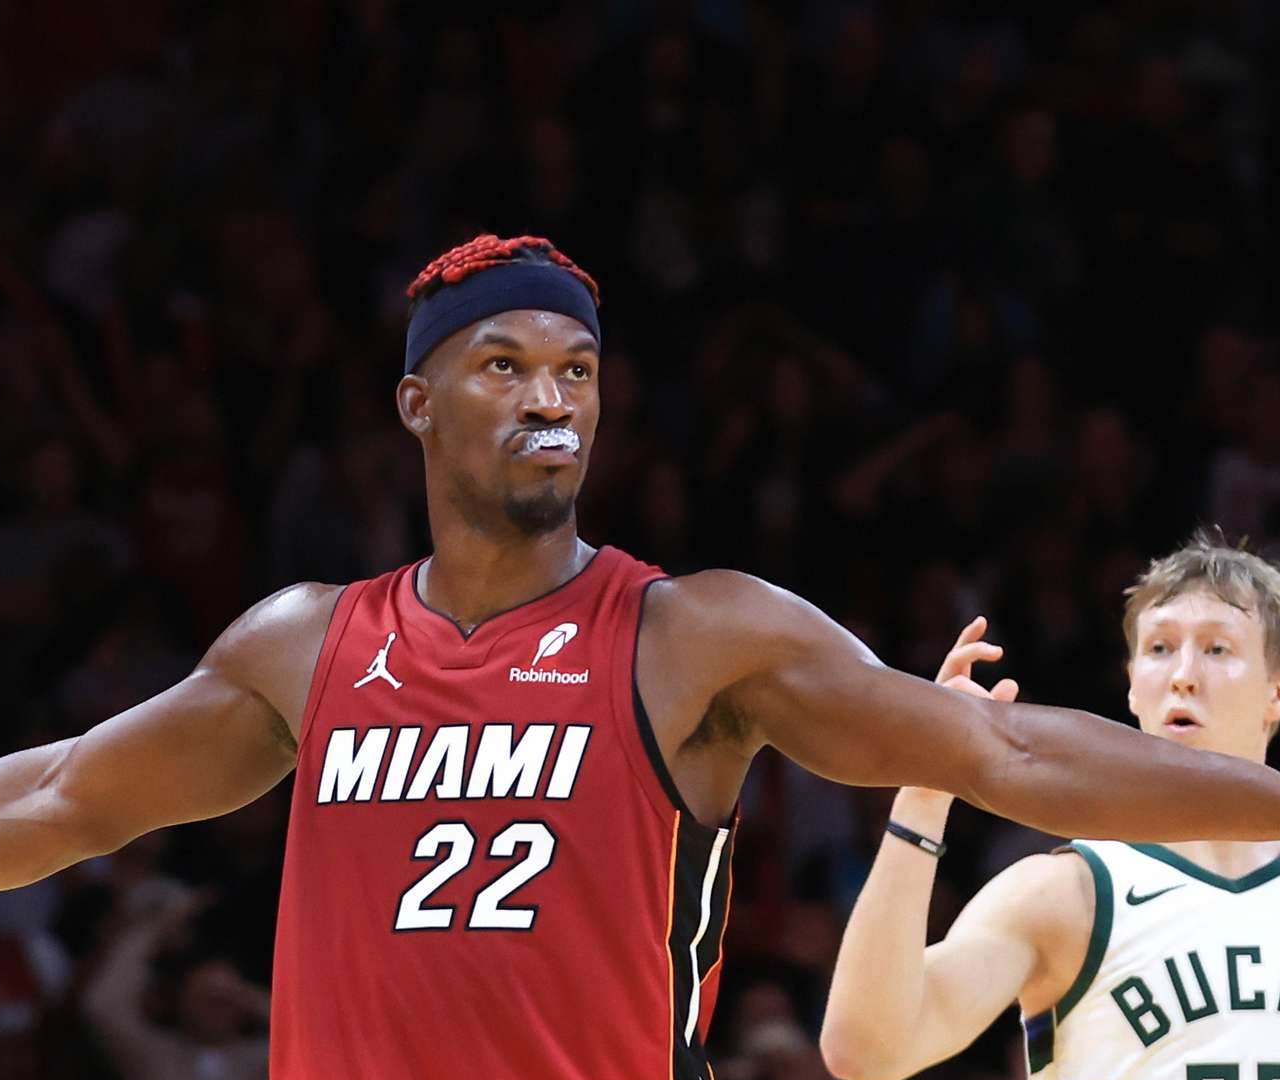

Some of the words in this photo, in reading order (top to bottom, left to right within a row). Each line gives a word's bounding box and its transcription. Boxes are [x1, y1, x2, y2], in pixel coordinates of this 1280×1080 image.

[509, 667, 589, 684] Robinhood
[317, 723, 592, 804] MIAMI
[393, 821, 557, 931] 22
